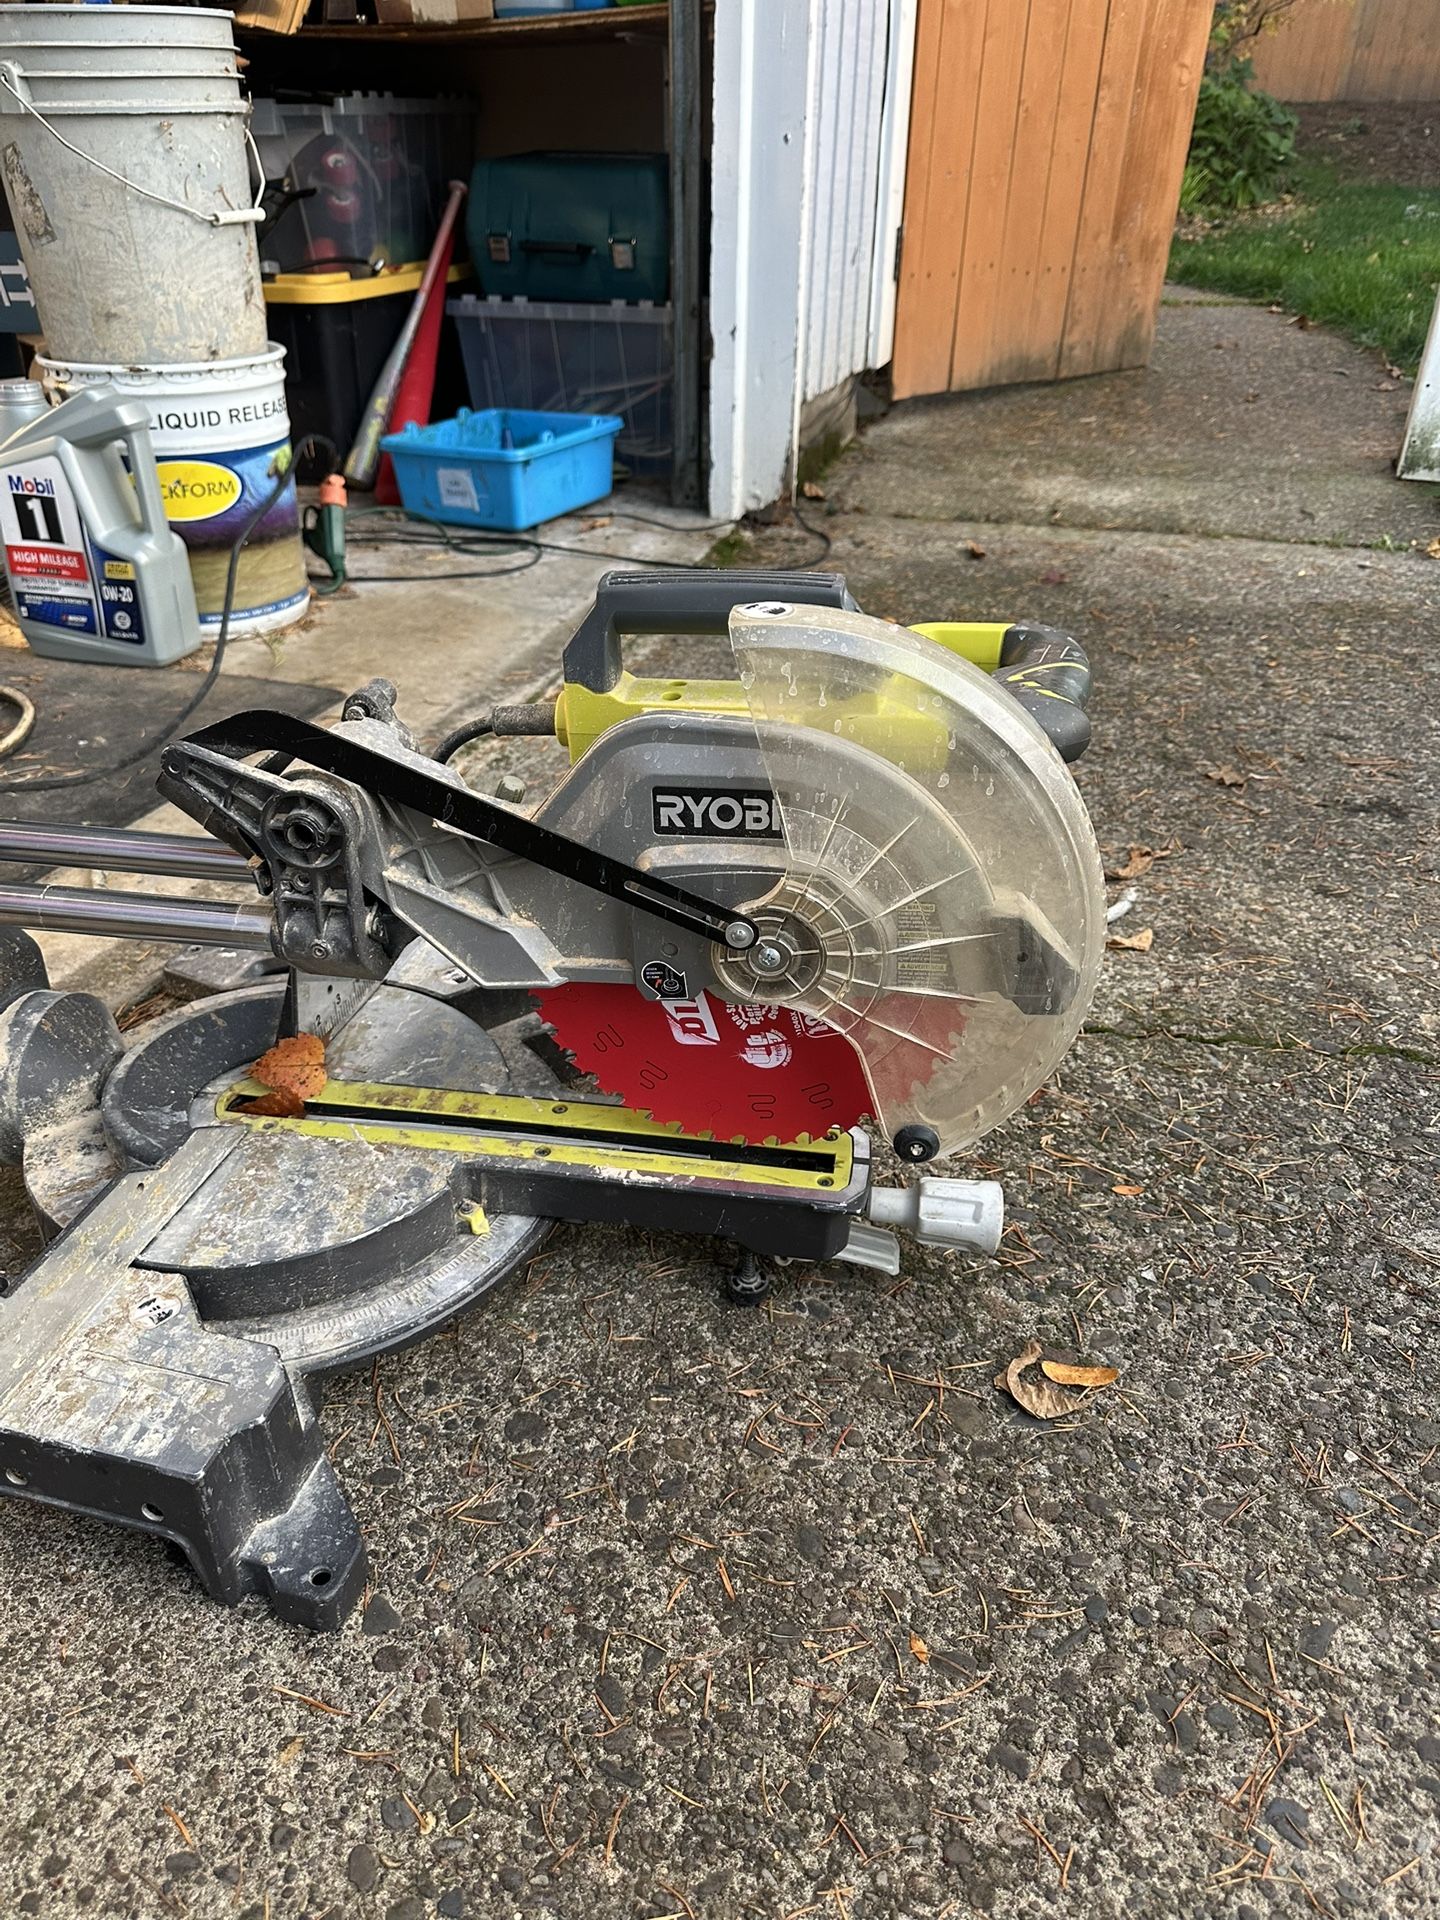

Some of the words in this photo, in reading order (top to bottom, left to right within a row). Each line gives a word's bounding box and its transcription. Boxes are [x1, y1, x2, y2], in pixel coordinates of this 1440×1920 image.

[149, 411, 221, 430] IQUID
[8, 475, 55, 495] Mobil
[26, 498, 51, 540] 1
[12, 551, 38, 563] HIGH
[39, 553, 80, 568] MILEAGE
[102, 585, 134, 603] 0W-20
[656, 795, 780, 831] RYOBI
[315, 1014, 321, 1027] 2
